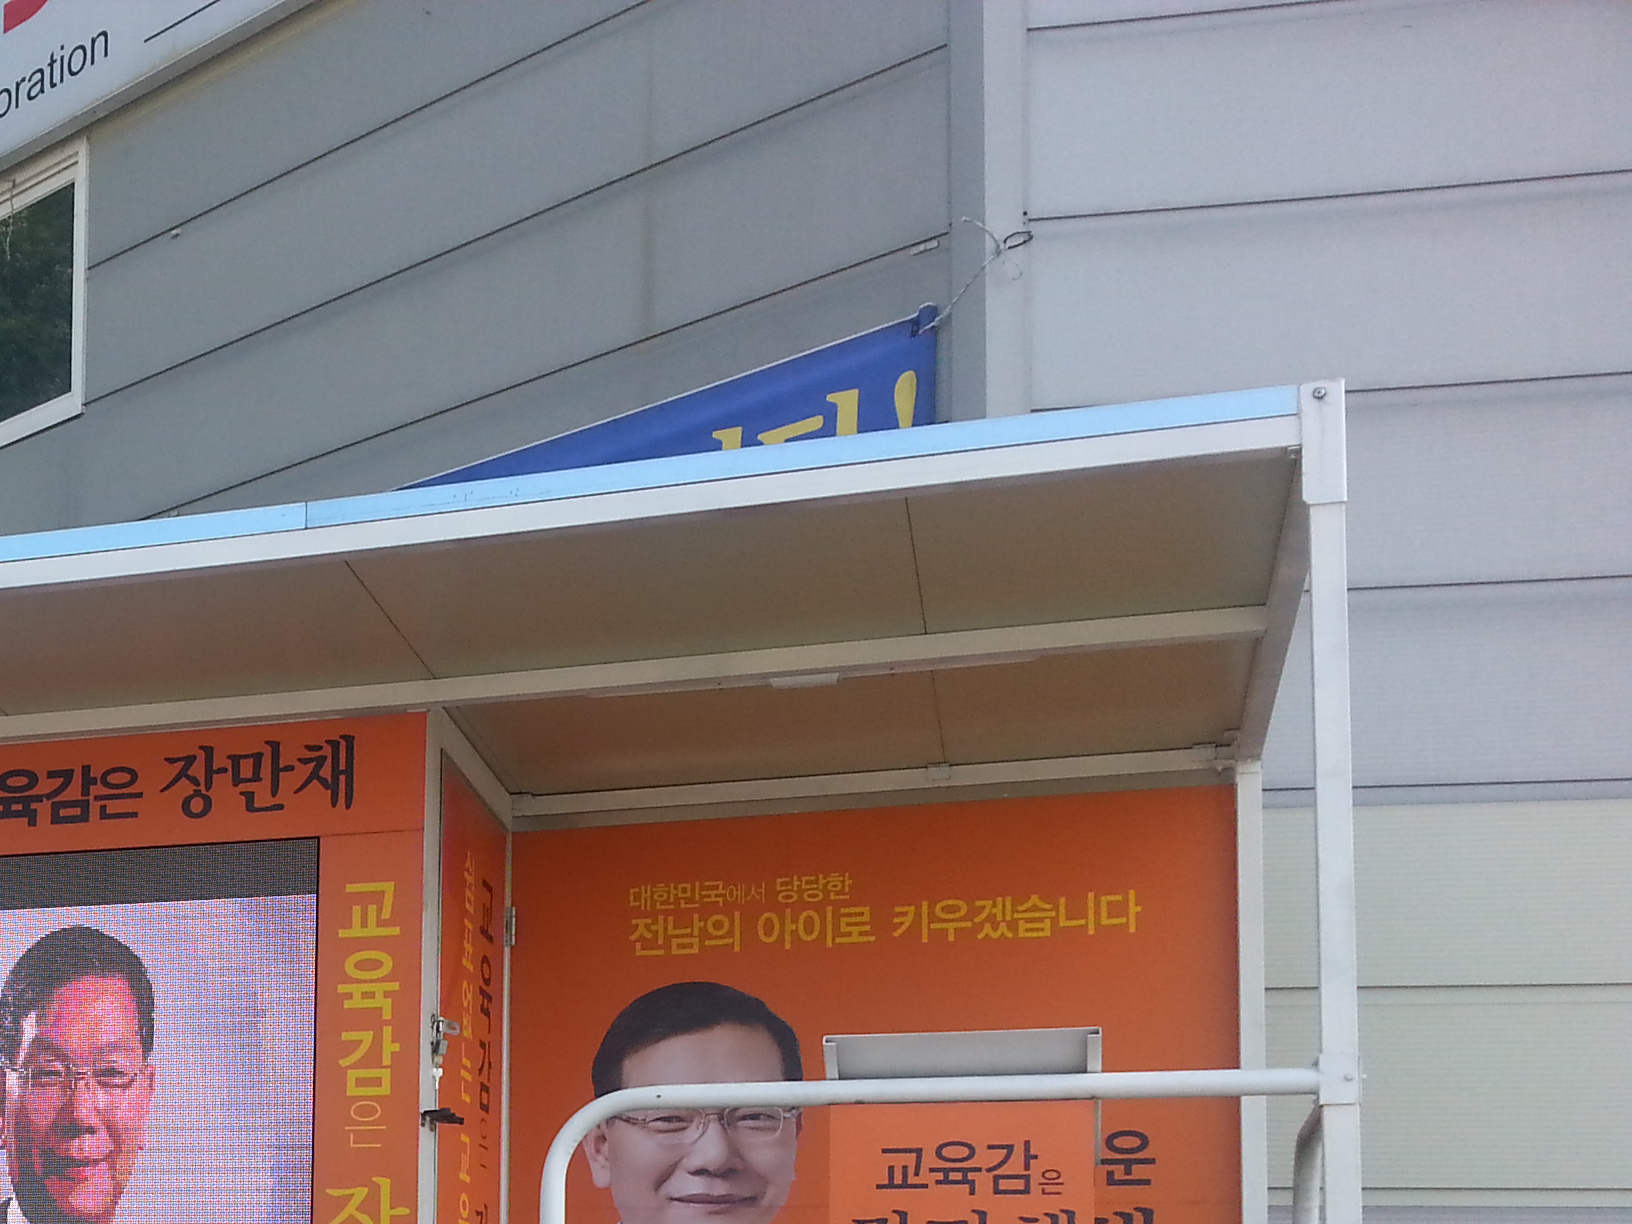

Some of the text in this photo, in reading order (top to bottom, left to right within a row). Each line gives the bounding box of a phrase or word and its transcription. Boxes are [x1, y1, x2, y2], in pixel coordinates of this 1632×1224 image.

[159, 734, 356, 818] 장만채
[628, 872, 852, 911] 대한민국에서 당당한
[628, 889, 1142, 957] 전남의 아이로 키우겠습니다
[336, 881, 400, 1149] 교육감은
[875, 1139, 1065, 1196] 교육감은
